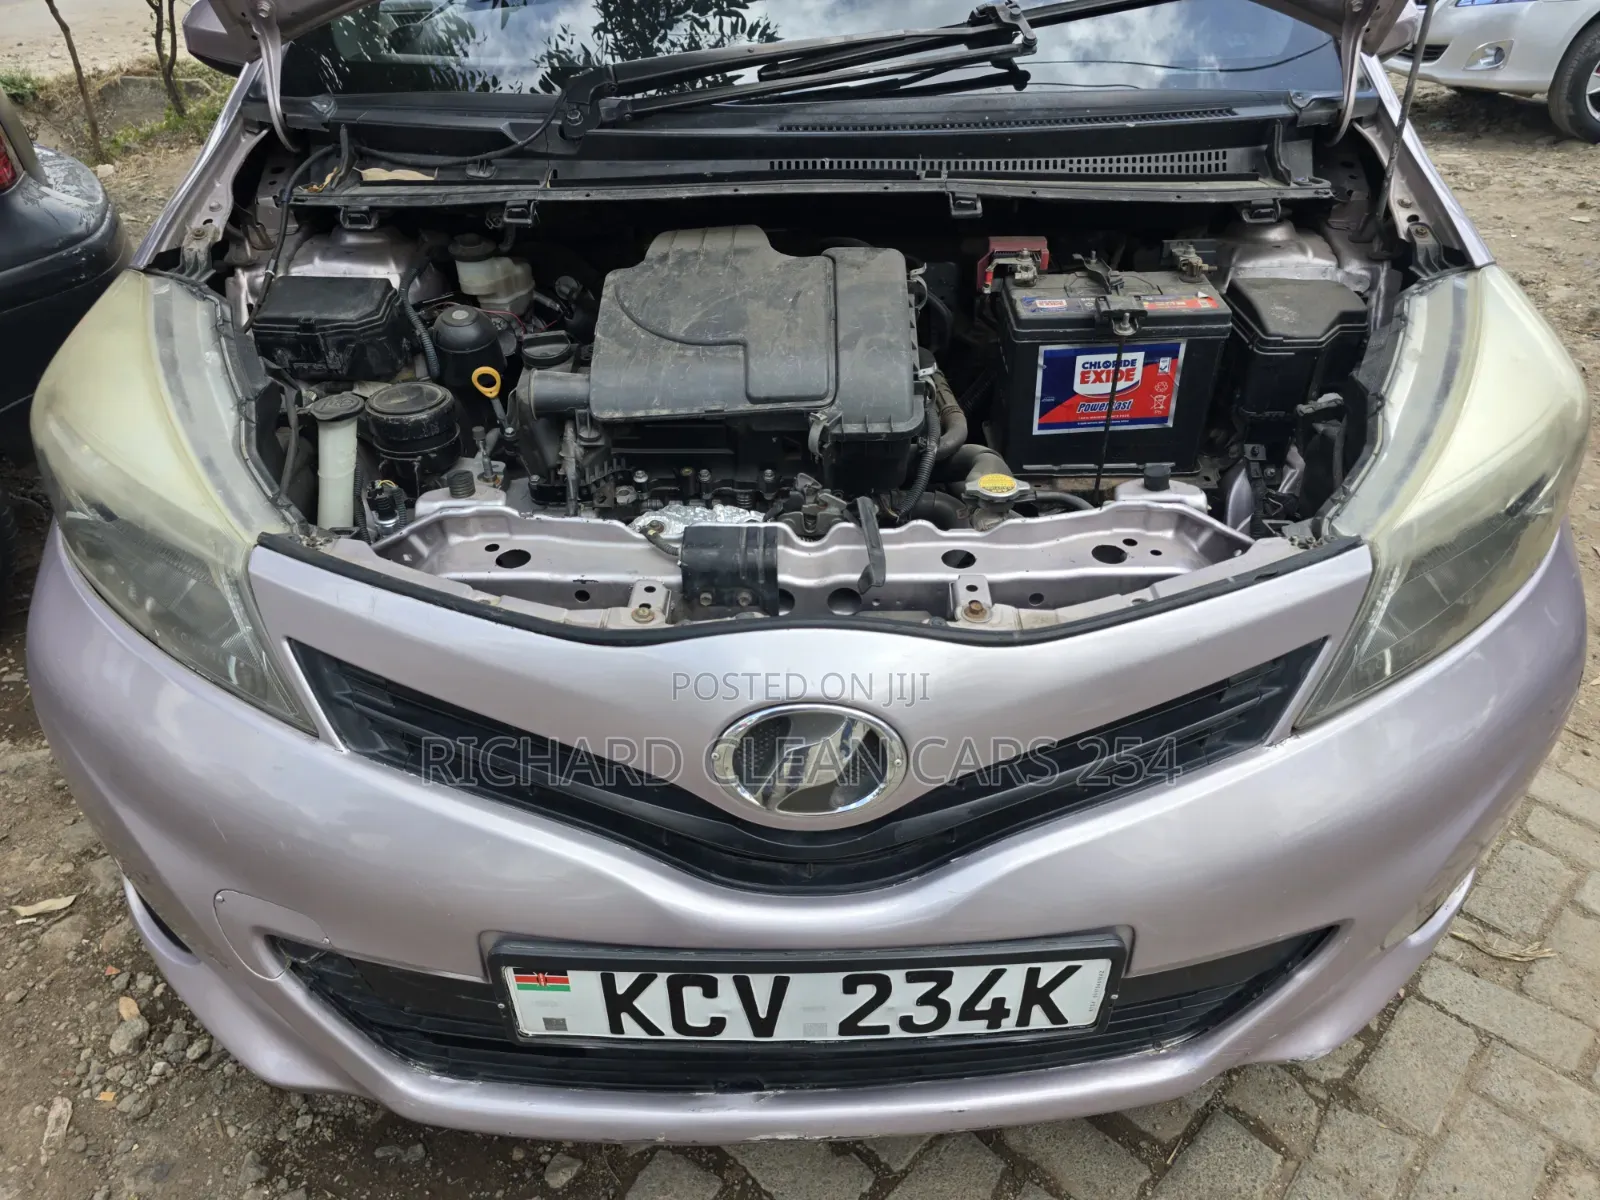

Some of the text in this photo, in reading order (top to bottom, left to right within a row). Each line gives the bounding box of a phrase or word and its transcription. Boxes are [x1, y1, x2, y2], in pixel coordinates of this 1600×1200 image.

[1082, 359, 1137, 369] CHLORIDE
[1080, 368, 1136, 385] EXIDE
[600, 972, 790, 1038] KCV
[838, 965, 1082, 1037] 234K
